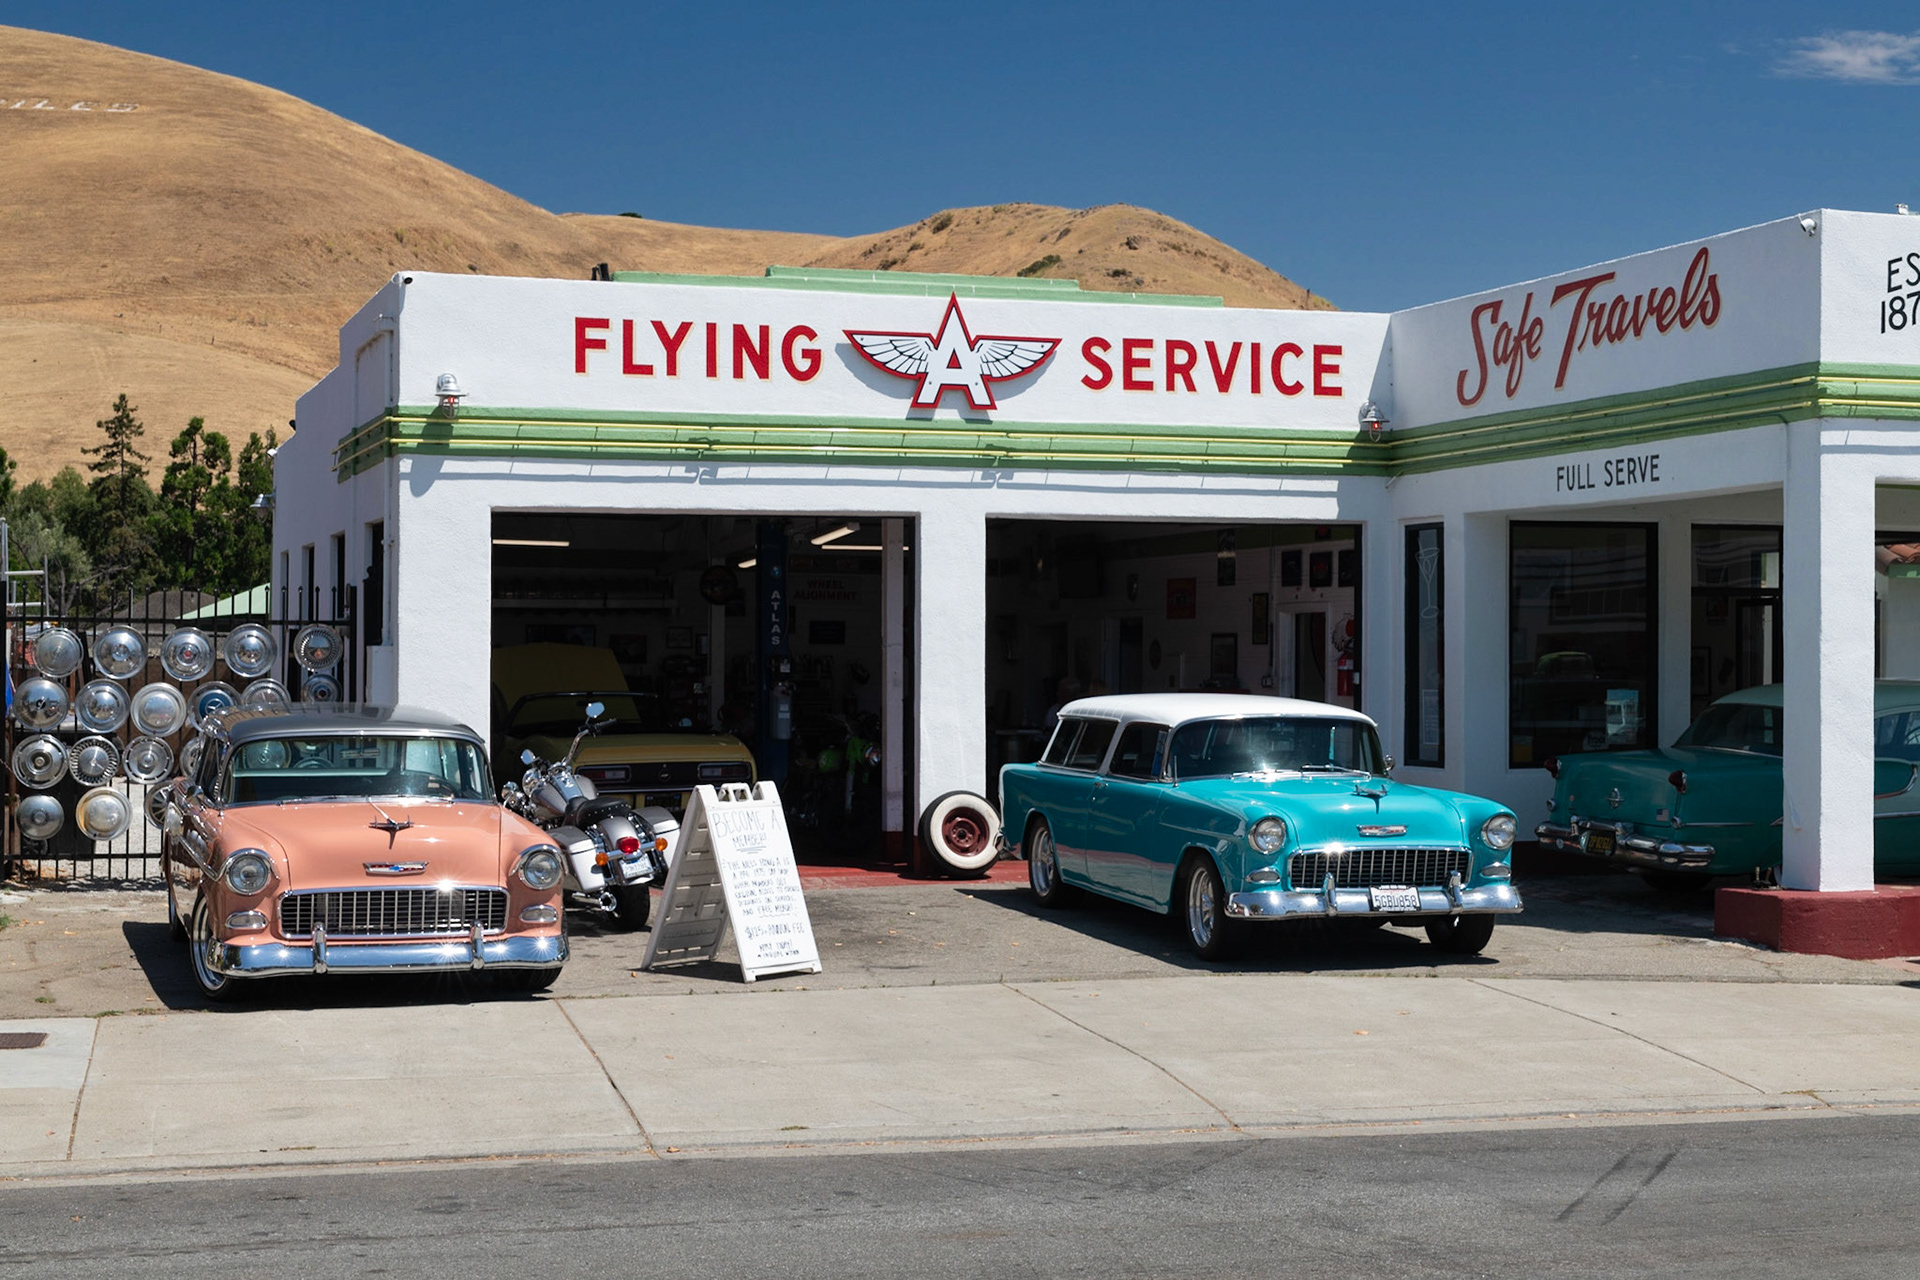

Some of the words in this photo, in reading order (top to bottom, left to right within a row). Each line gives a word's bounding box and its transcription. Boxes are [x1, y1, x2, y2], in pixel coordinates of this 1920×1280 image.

[0, 98, 140, 112] ILES
[1457, 292, 1544, 407] Safe
[1551, 246, 1722, 390] Travels
[575, 316, 823, 383] FLYING
[1081, 336, 1344, 398] SERVICE
[1556, 462, 1597, 493] FULL
[1603, 454, 1661, 488] SERVE
[807, 579, 846, 590] WHEEL
[771, 590, 781, 646] ATLAS
[712, 809, 765, 839] BECOME
[771, 809, 782, 831] A
[792, 922, 805, 934] FEE
